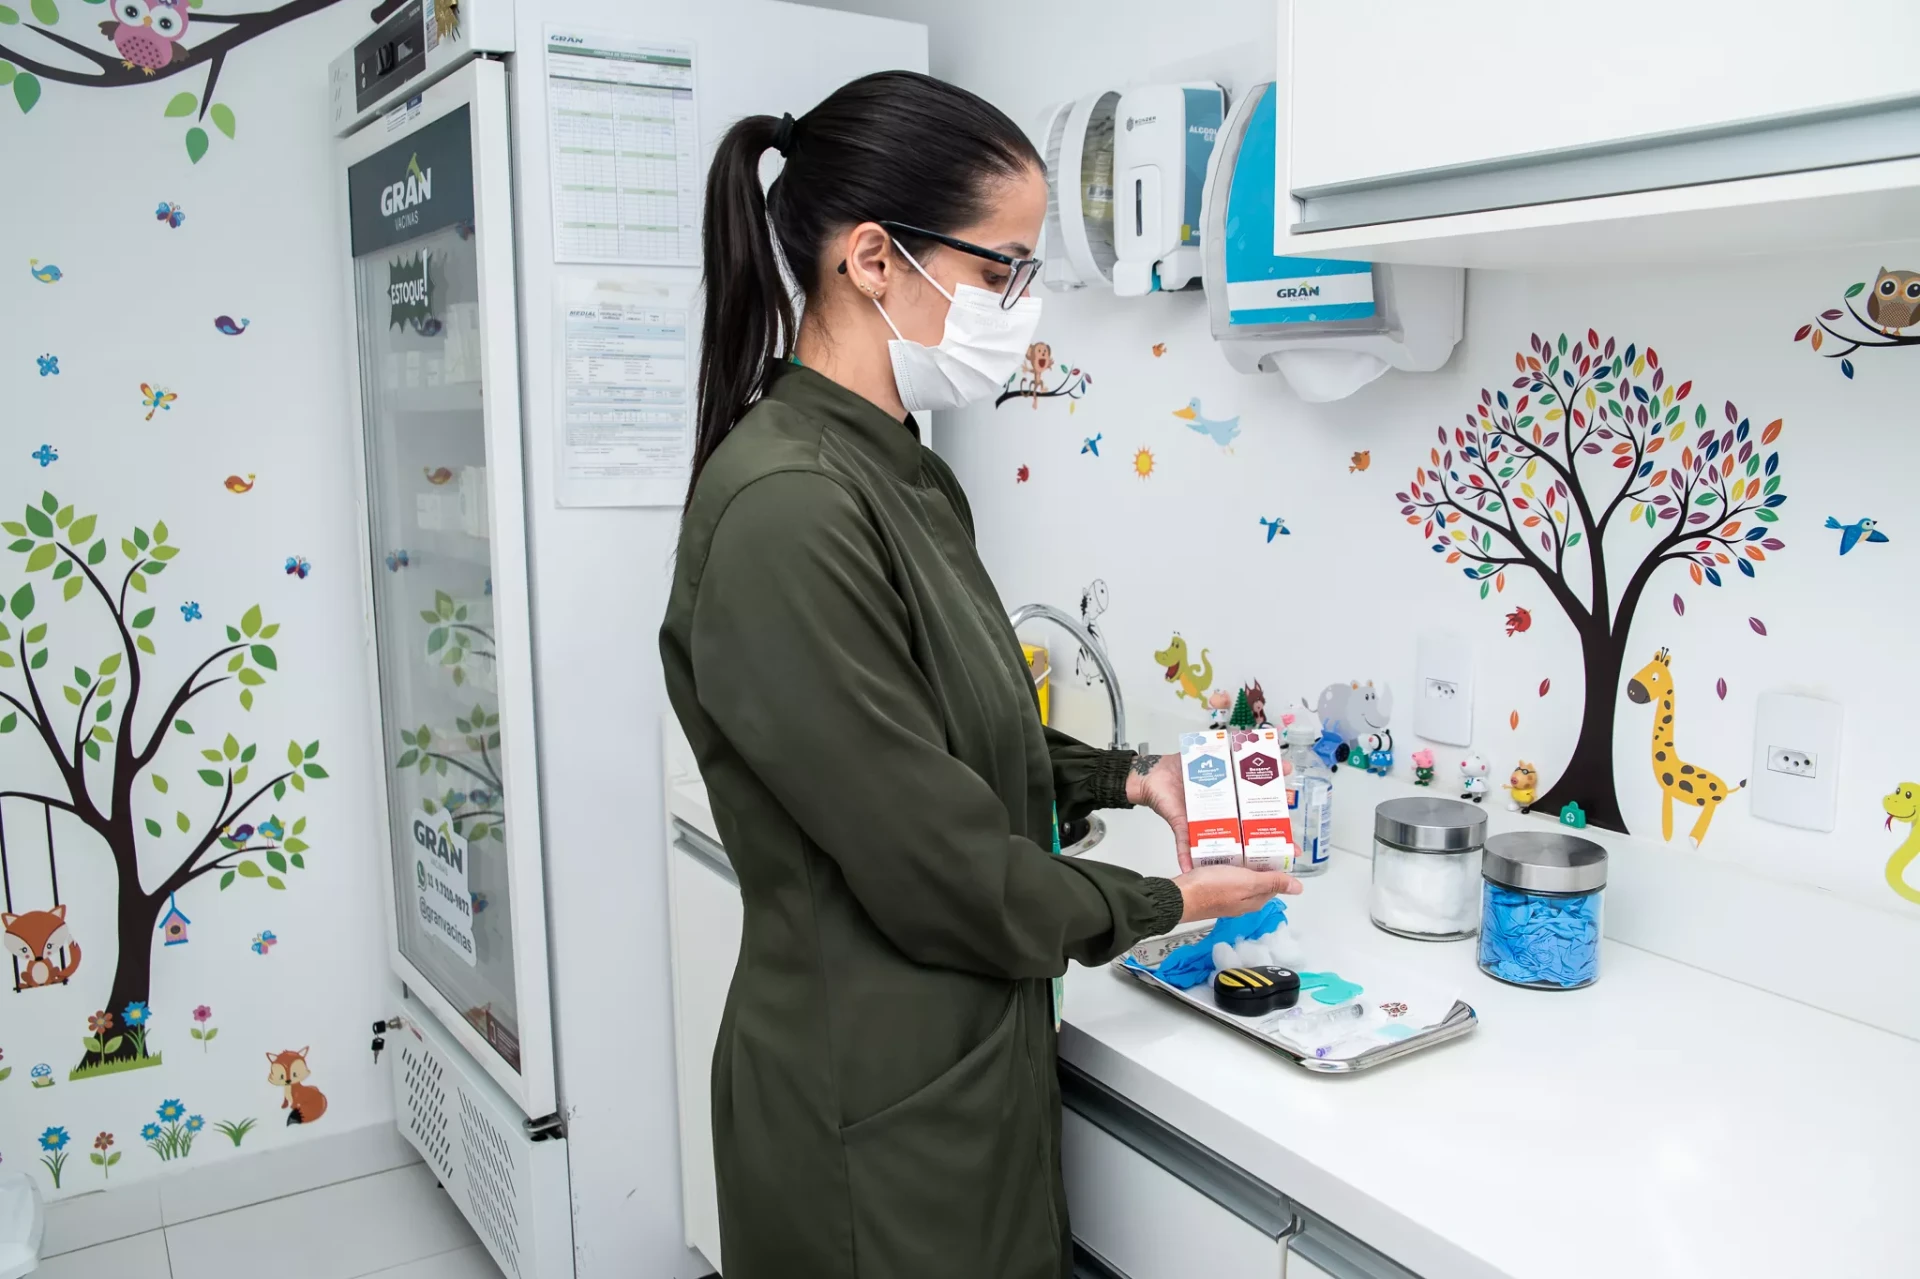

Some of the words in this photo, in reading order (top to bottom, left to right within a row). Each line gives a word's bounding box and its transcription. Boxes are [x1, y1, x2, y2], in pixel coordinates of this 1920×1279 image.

[551, 35, 584, 44] GRAN
[381, 168, 432, 217] GRAN
[395, 210, 419, 231] VACINAS
[390, 248, 429, 307] ESTOQUE!
[1276, 286, 1320, 299] GRAN
[414, 819, 463, 874] GRAN
[419, 896, 473, 954] @granvacinas
